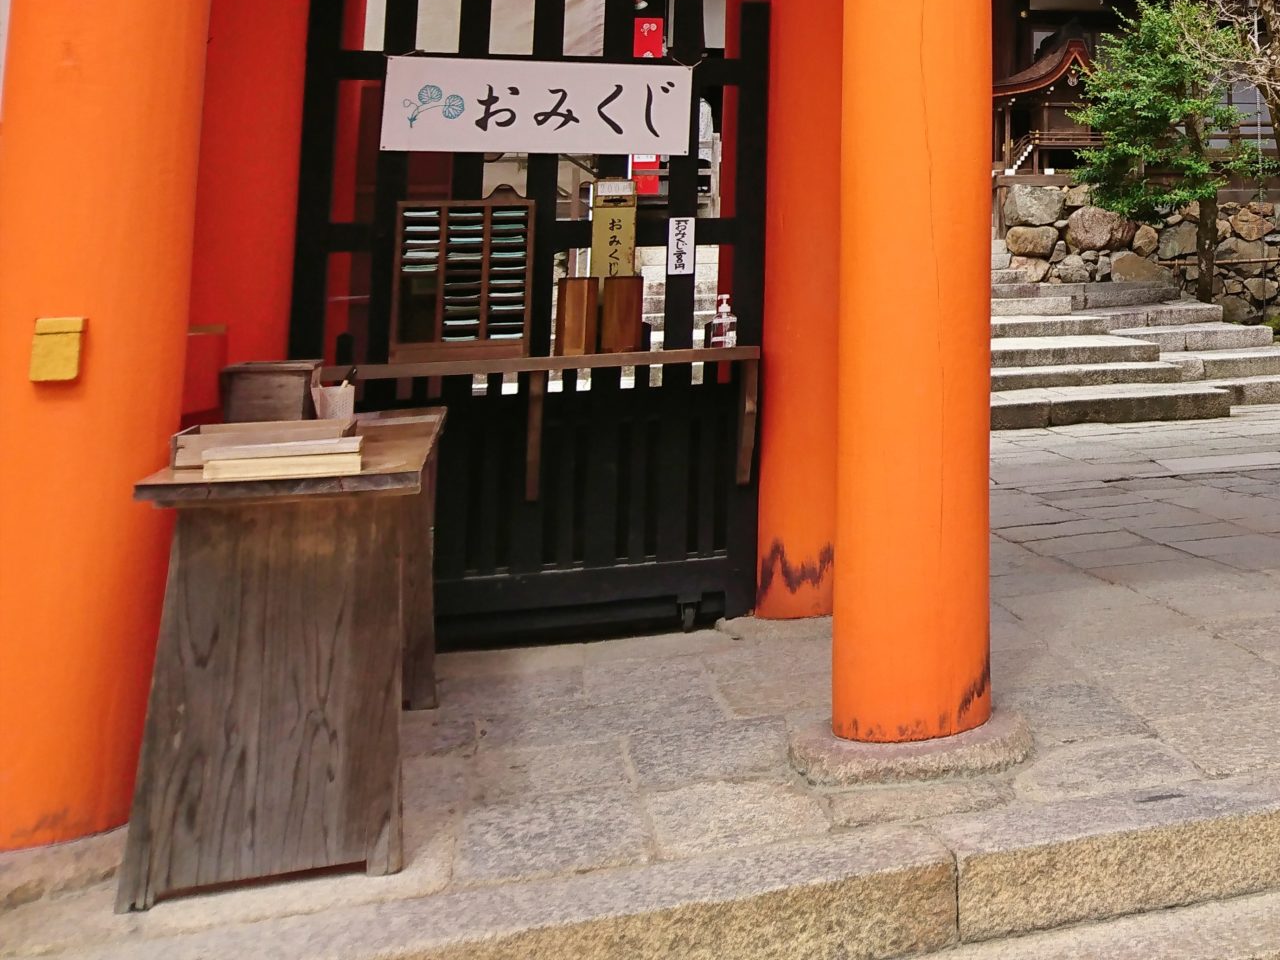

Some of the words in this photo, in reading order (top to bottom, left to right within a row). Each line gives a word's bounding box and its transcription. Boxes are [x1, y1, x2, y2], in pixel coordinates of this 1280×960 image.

[475, 81, 675, 138] おみくじ
[609, 218, 622, 277] おみくじ
